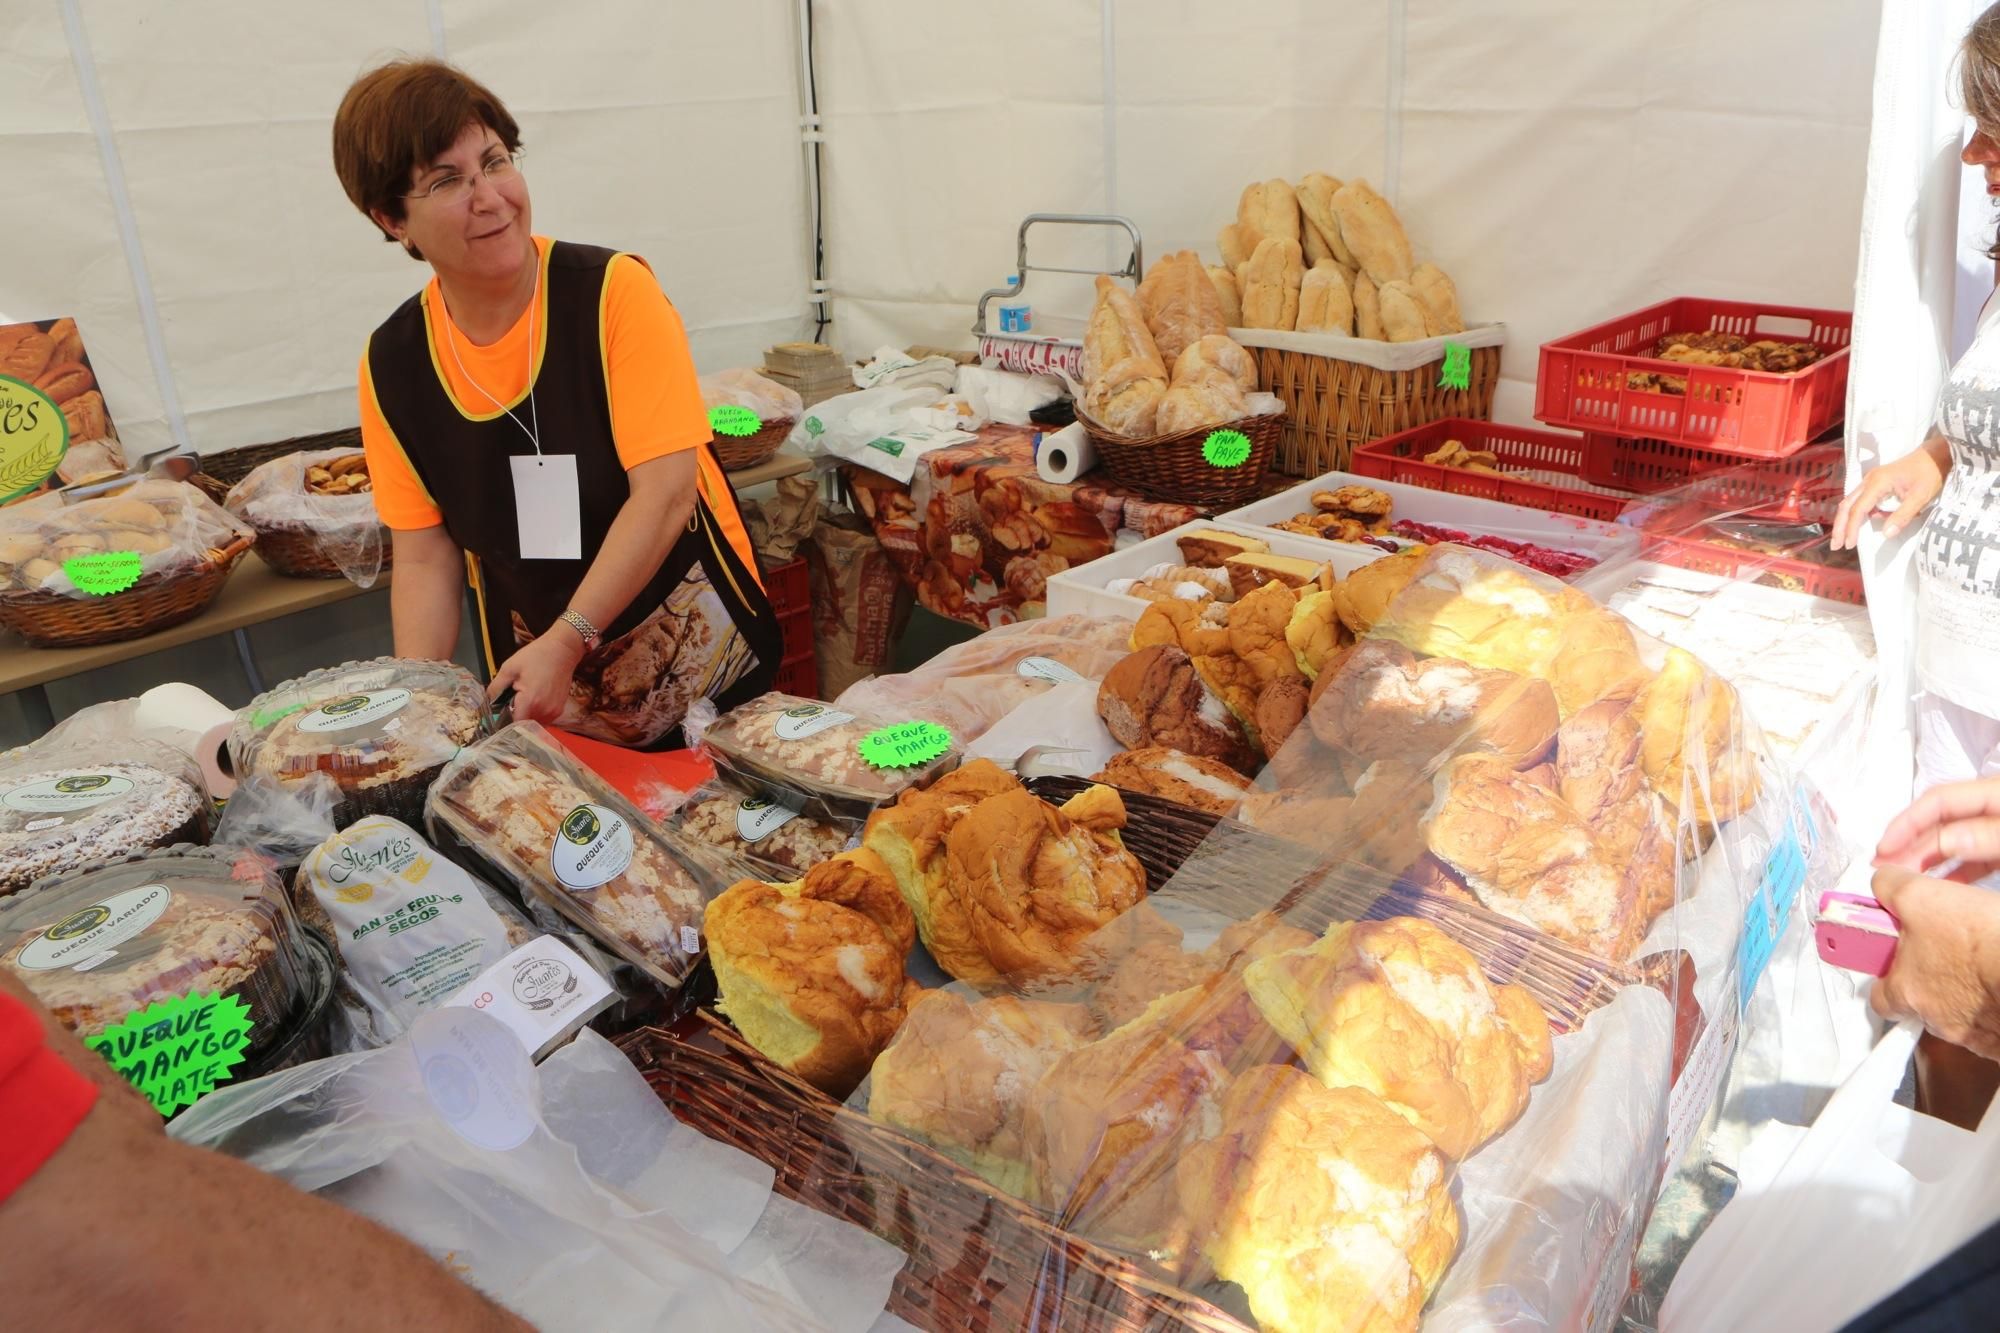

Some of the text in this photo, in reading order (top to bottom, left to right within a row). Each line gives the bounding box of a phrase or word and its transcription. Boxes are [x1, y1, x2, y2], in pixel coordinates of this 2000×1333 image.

[1214, 434, 1240, 446] PAN
[318, 694, 406, 727] QUEQUE VARIADO
[873, 723, 929, 746] QUEQUE
[895, 733, 948, 758] MANGO
[576, 840, 605, 872] QUEQUE
[51, 891, 159, 959] QUEQUE VARIADO
[352, 917, 382, 941] PAN
[385, 909, 407, 922] DE
[388, 905, 440, 935] SECOS
[95, 1002, 218, 1063] QUEQUE
[119, 1028, 242, 1088] MANGO
